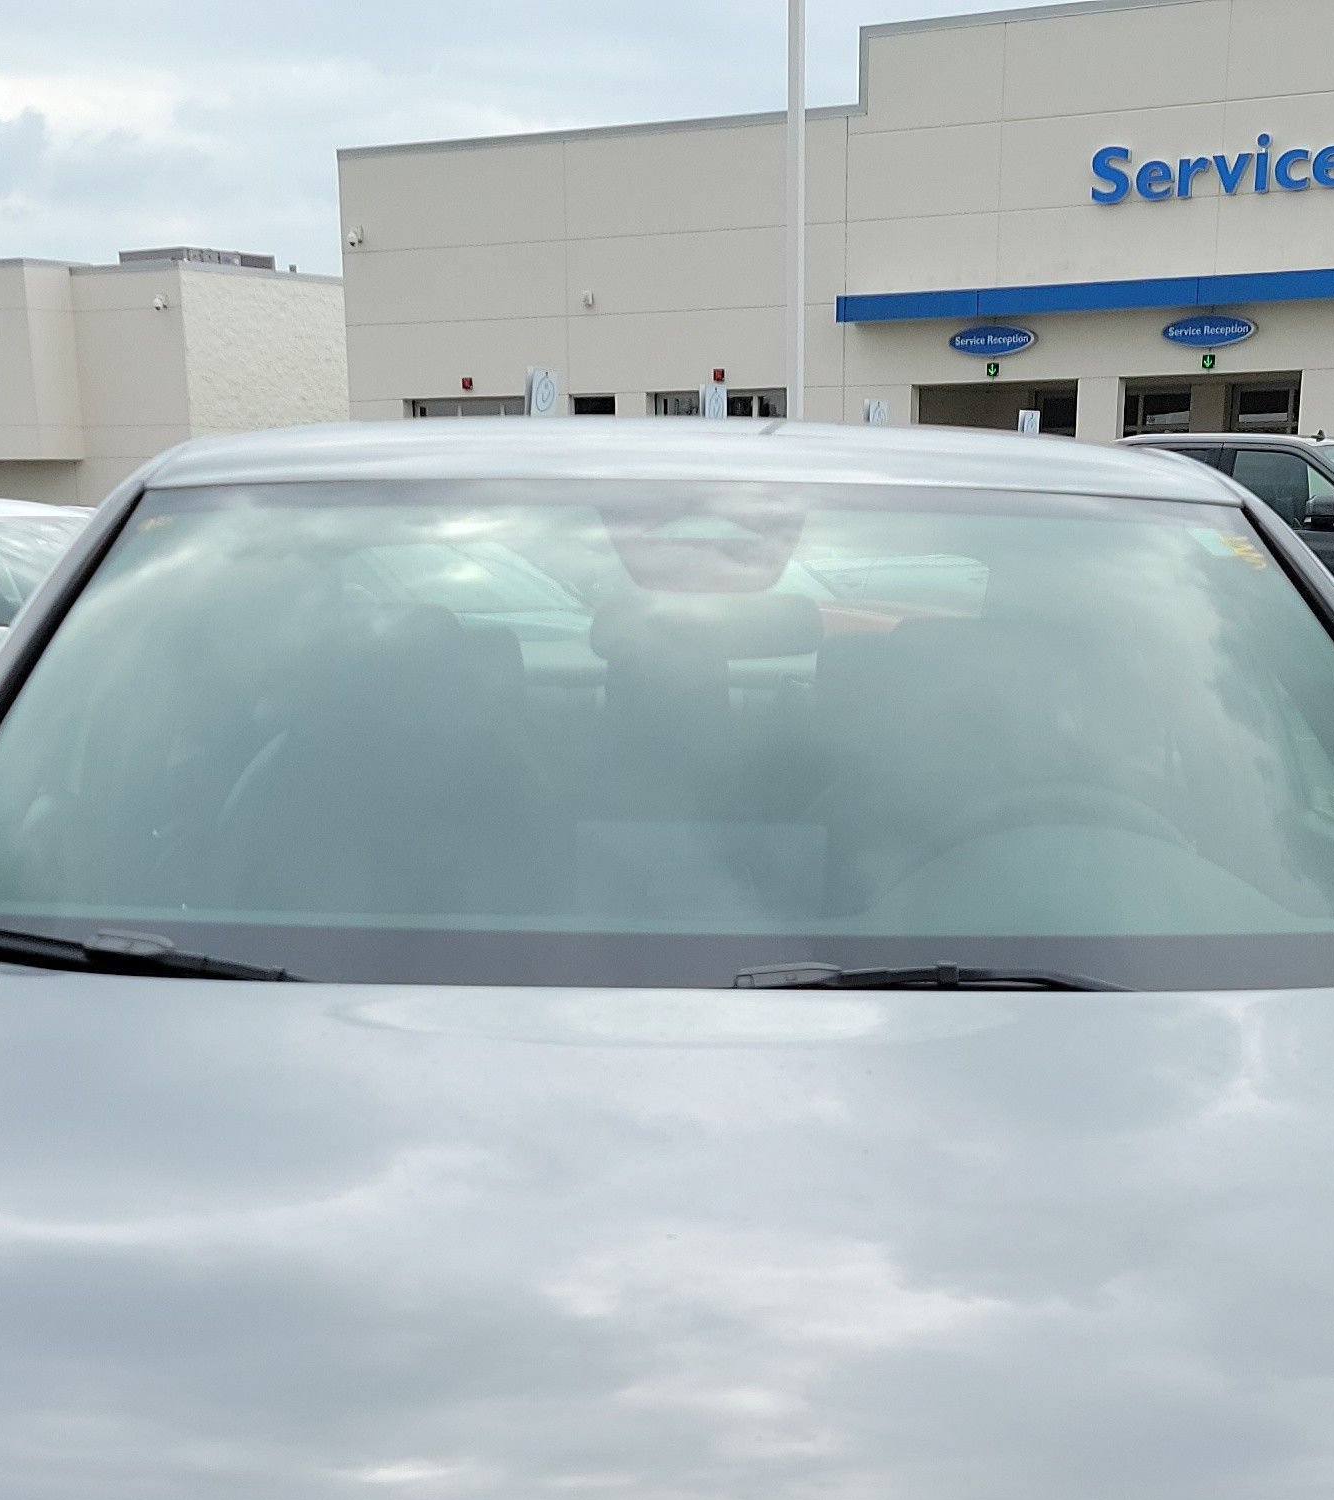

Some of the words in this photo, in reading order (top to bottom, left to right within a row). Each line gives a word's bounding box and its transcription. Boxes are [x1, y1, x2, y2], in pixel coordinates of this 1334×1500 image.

[1168, 326, 1202, 337] Service
[1204, 323, 1249, 337] Reception
[955, 336, 986, 346] Service
[987, 333, 1029, 347] Reception
